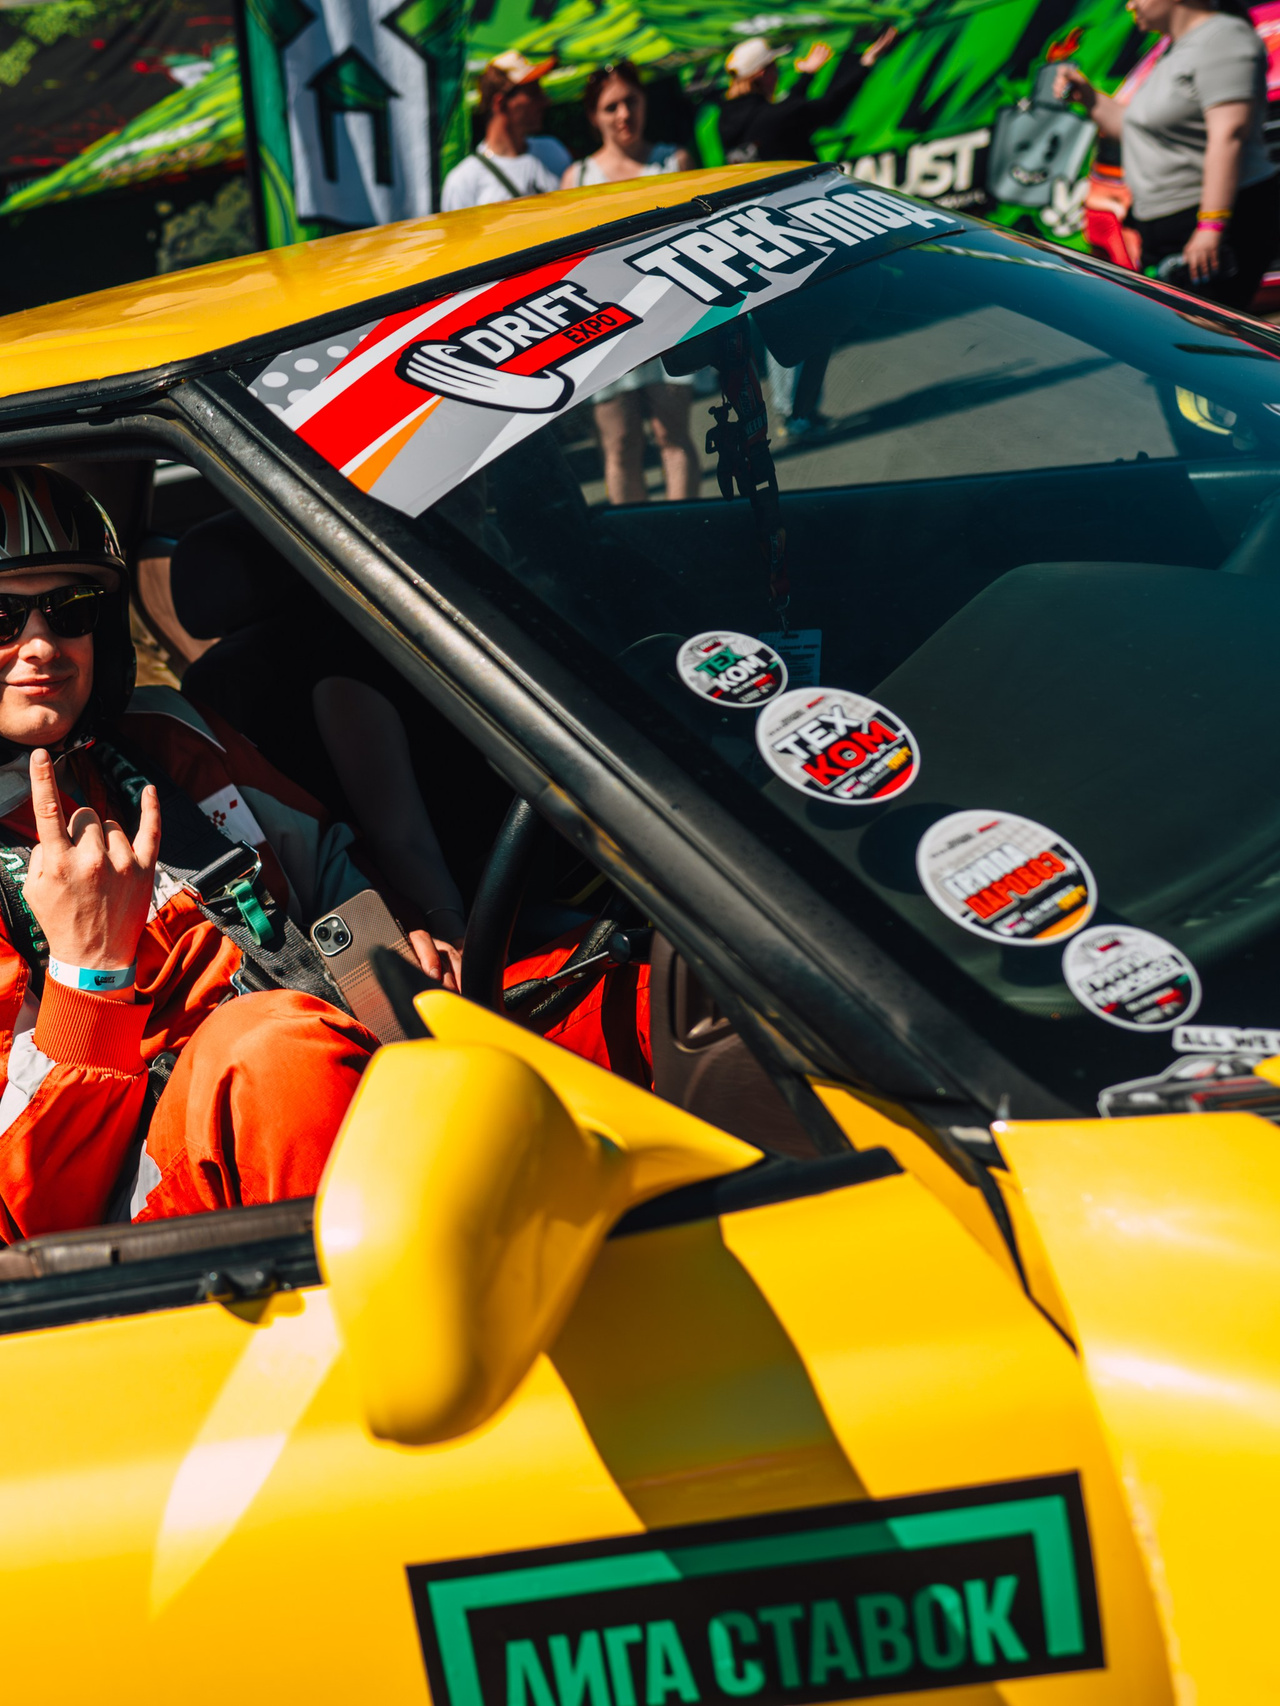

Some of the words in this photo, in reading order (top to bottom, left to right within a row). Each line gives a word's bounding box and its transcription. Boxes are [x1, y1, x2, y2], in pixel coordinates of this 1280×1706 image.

[843, 128, 991, 197] AUST
[459, 283, 599, 364] DRIFT
[561, 312, 619, 345] EXPO
[694, 646, 743, 678] ТЕХ
[713, 653, 769, 692] КОМ
[772, 704, 862, 760] ТЕХ
[801, 719, 899, 786] КОМ
[963, 851, 1067, 920] ПАРОВОЗ
[1181, 1032, 1223, 1047] ALL
[505, 1618, 700, 1706] ЛИГА
[707, 1574, 1029, 1698] СТАВОК
